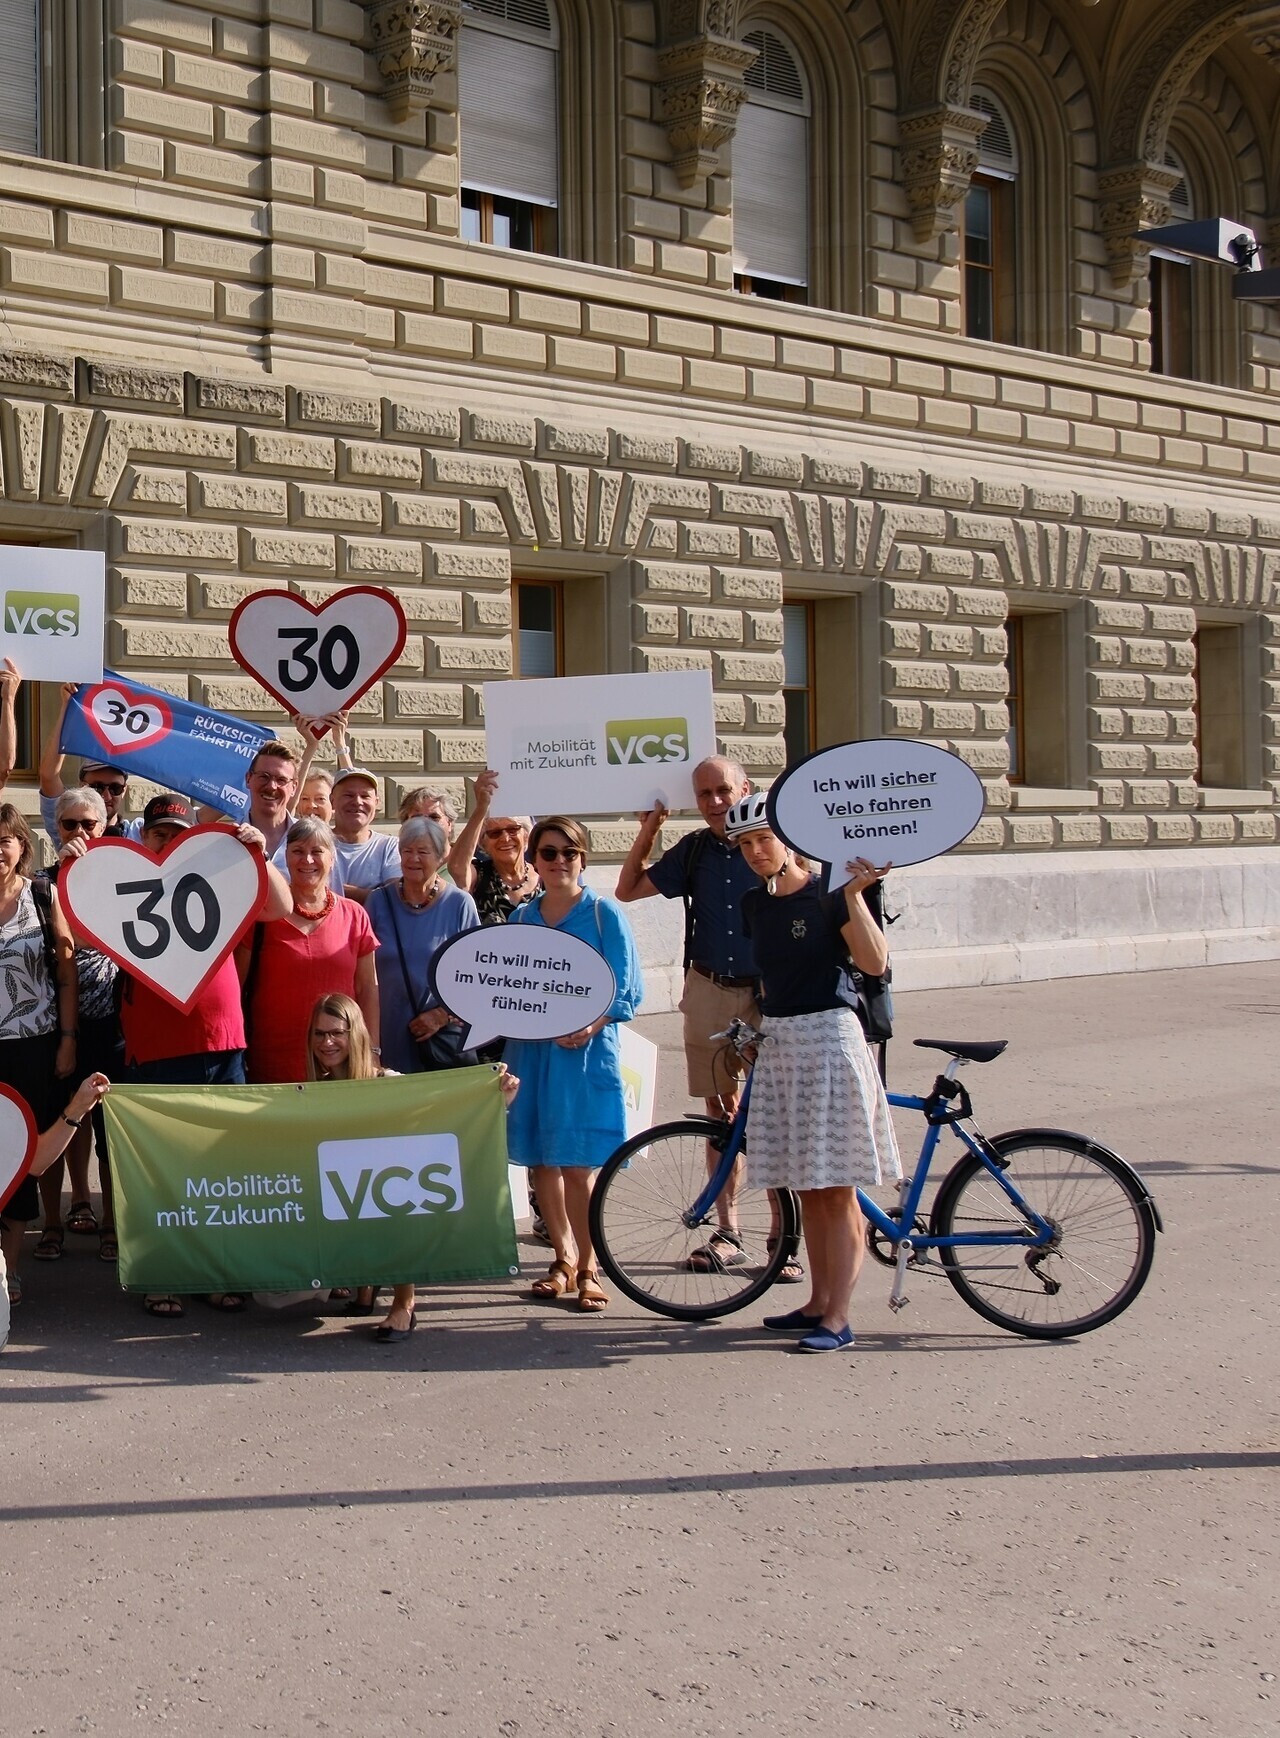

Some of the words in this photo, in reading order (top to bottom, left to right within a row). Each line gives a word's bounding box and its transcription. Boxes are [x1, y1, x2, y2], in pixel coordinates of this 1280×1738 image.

[7, 606, 77, 637] VCS
[278, 625, 360, 692] 30
[100, 700, 150, 735] 30
[189, 729, 233, 749] FÄHRT
[527, 739, 596, 753] Mobilität
[609, 733, 686, 764] VCS
[510, 757, 535, 770] mit
[538, 754, 597, 769] Zukunft
[813, 778, 840, 793] Ich
[844, 774, 876, 790] will
[881, 771, 937, 787] sicher
[223, 789, 245, 808] VCS
[824, 801, 864, 817] Velo
[869, 797, 931, 813] fahren
[843, 820, 918, 840] können!
[115, 872, 221, 960] 30
[474, 950, 498, 965] Ich
[502, 954, 529, 968] will
[533, 957, 571, 972] mich
[454, 970, 474, 984] im
[478, 973, 540, 990] Verkehr
[542, 980, 592, 996] sicher
[491, 996, 548, 1014] fühlen!
[185, 1173, 304, 1198] Mobilität
[325, 1162, 458, 1219] VCS
[156, 1205, 199, 1227] mit
[204, 1201, 306, 1226] Zukunft
